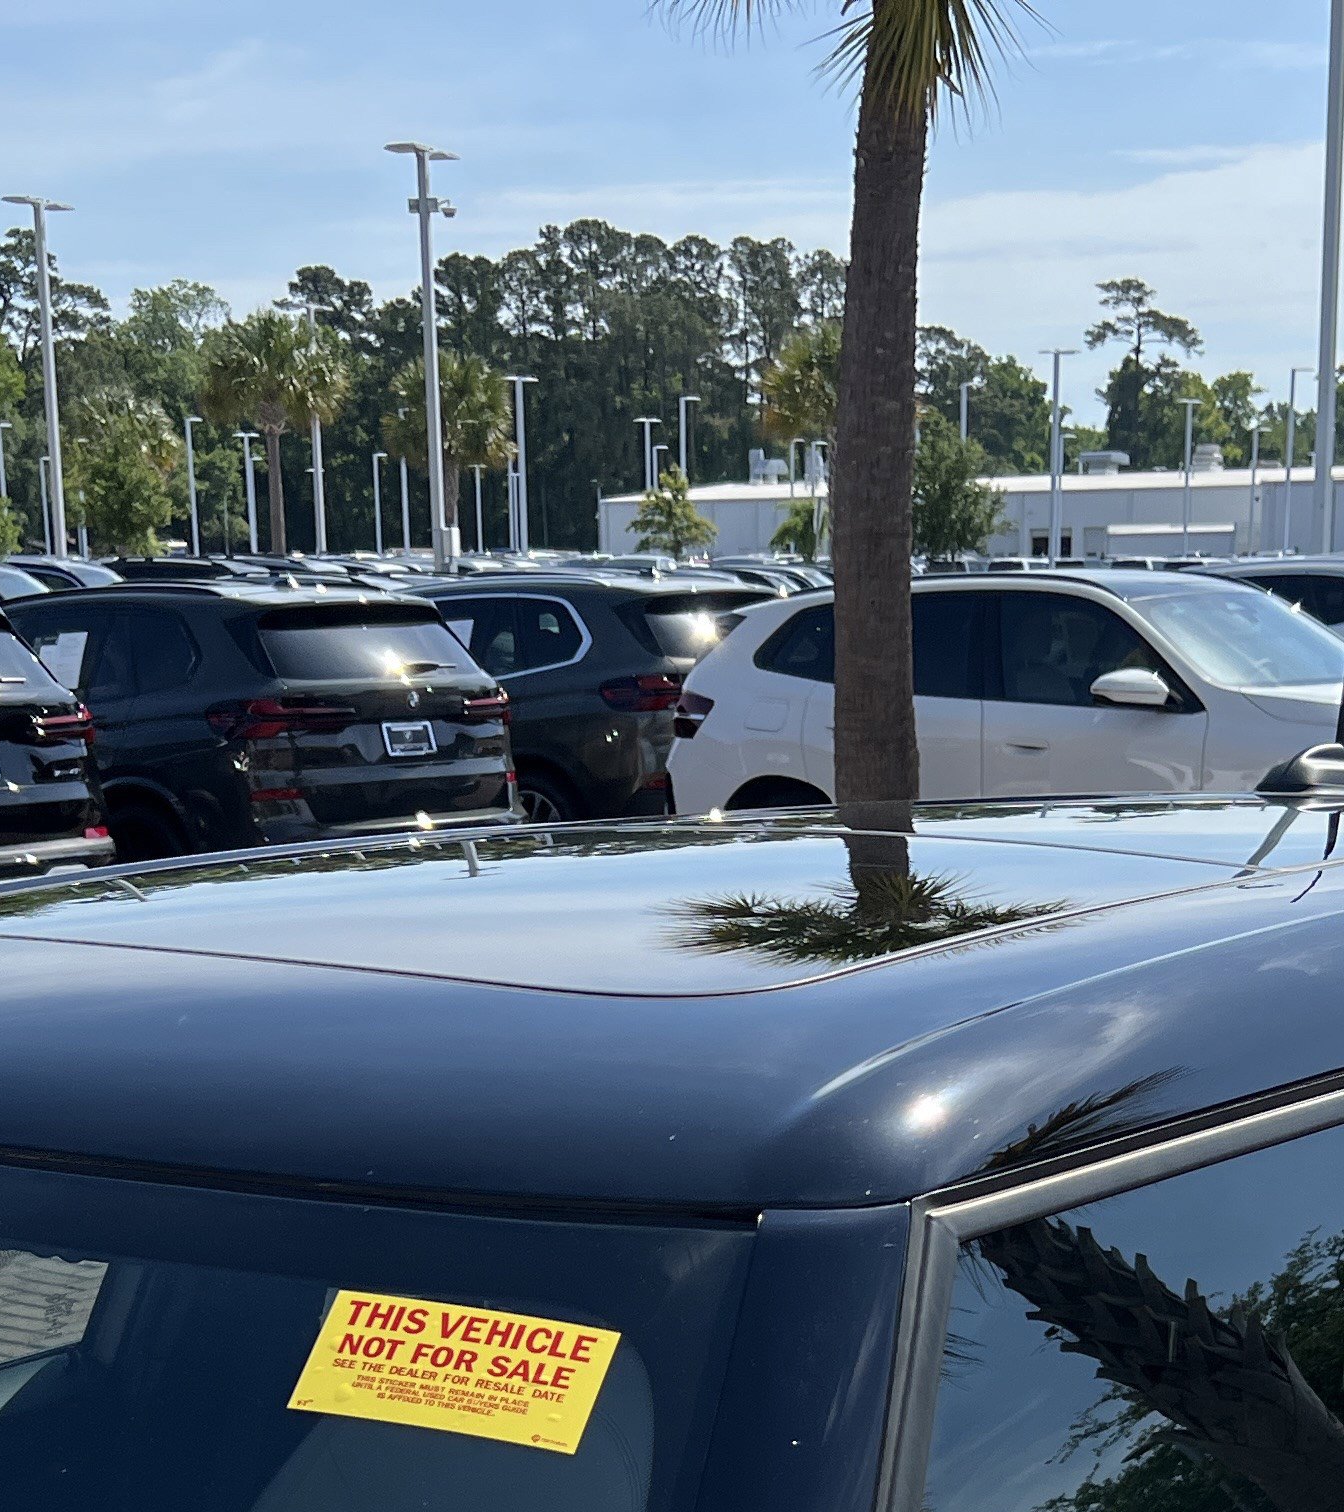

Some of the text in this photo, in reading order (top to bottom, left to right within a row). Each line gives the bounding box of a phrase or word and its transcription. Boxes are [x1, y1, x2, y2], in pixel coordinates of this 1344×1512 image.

[347, 1300, 598, 1363] THIS VEHICLE
[332, 1358, 565, 1403] SEE THE DEALER FOR RESALE DATE
[337, 1333, 576, 1389] NOT FOR SALE
[357, 1374, 376, 1383] THIS
[378, 1377, 416, 1388] STICKER
[419, 1383, 446, 1392] MUST
[448, 1388, 485, 1399] REMAIN
[500, 1397, 529, 1407] PLACE
[385, 1386, 420, 1397] FEDERAL
[447, 1395, 465, 1403] CAR
[424, 1398, 435, 1406] TO
[437, 1401, 456, 1409] THIS
